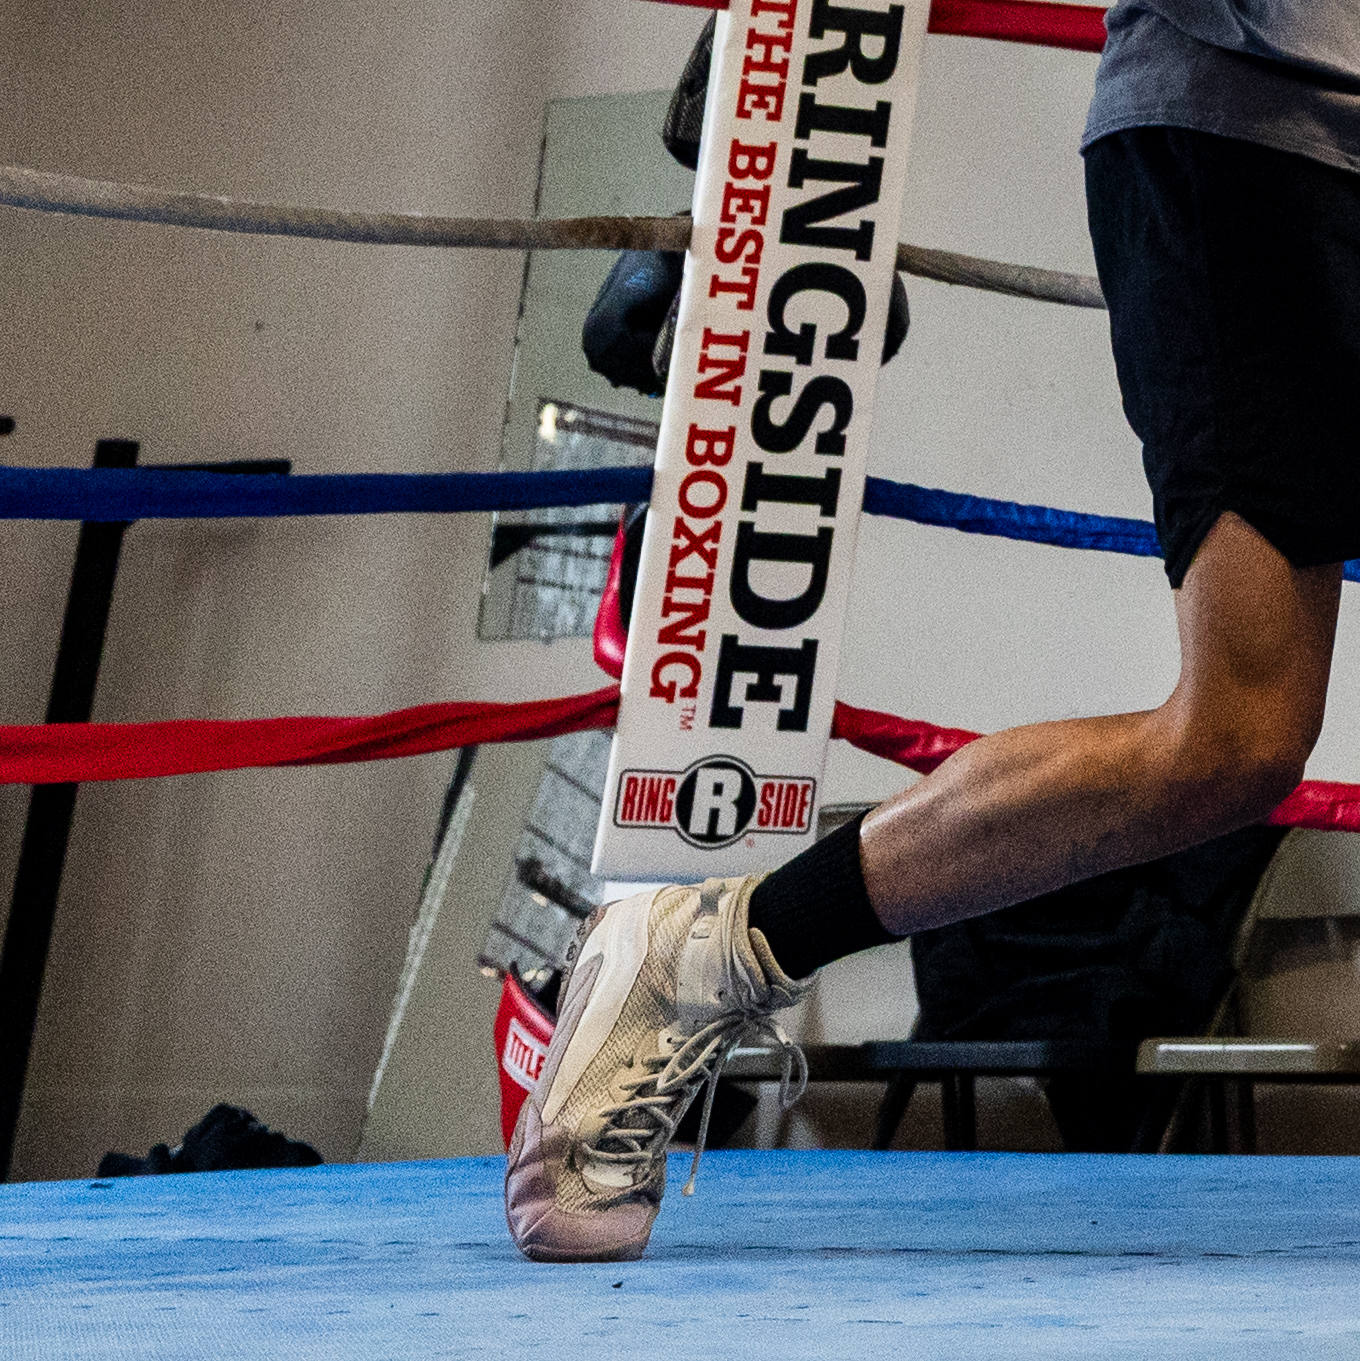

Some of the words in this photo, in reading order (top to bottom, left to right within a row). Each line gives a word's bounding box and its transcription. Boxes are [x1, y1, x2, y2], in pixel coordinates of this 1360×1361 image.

[708, 138, 778, 311] BEST
[693, 327, 750, 406] IN
[649, 423, 737, 704] BOXING
[621, 776, 676, 823] RING
[689, 767, 743, 835] R
[757, 782, 811, 828] SIDE
